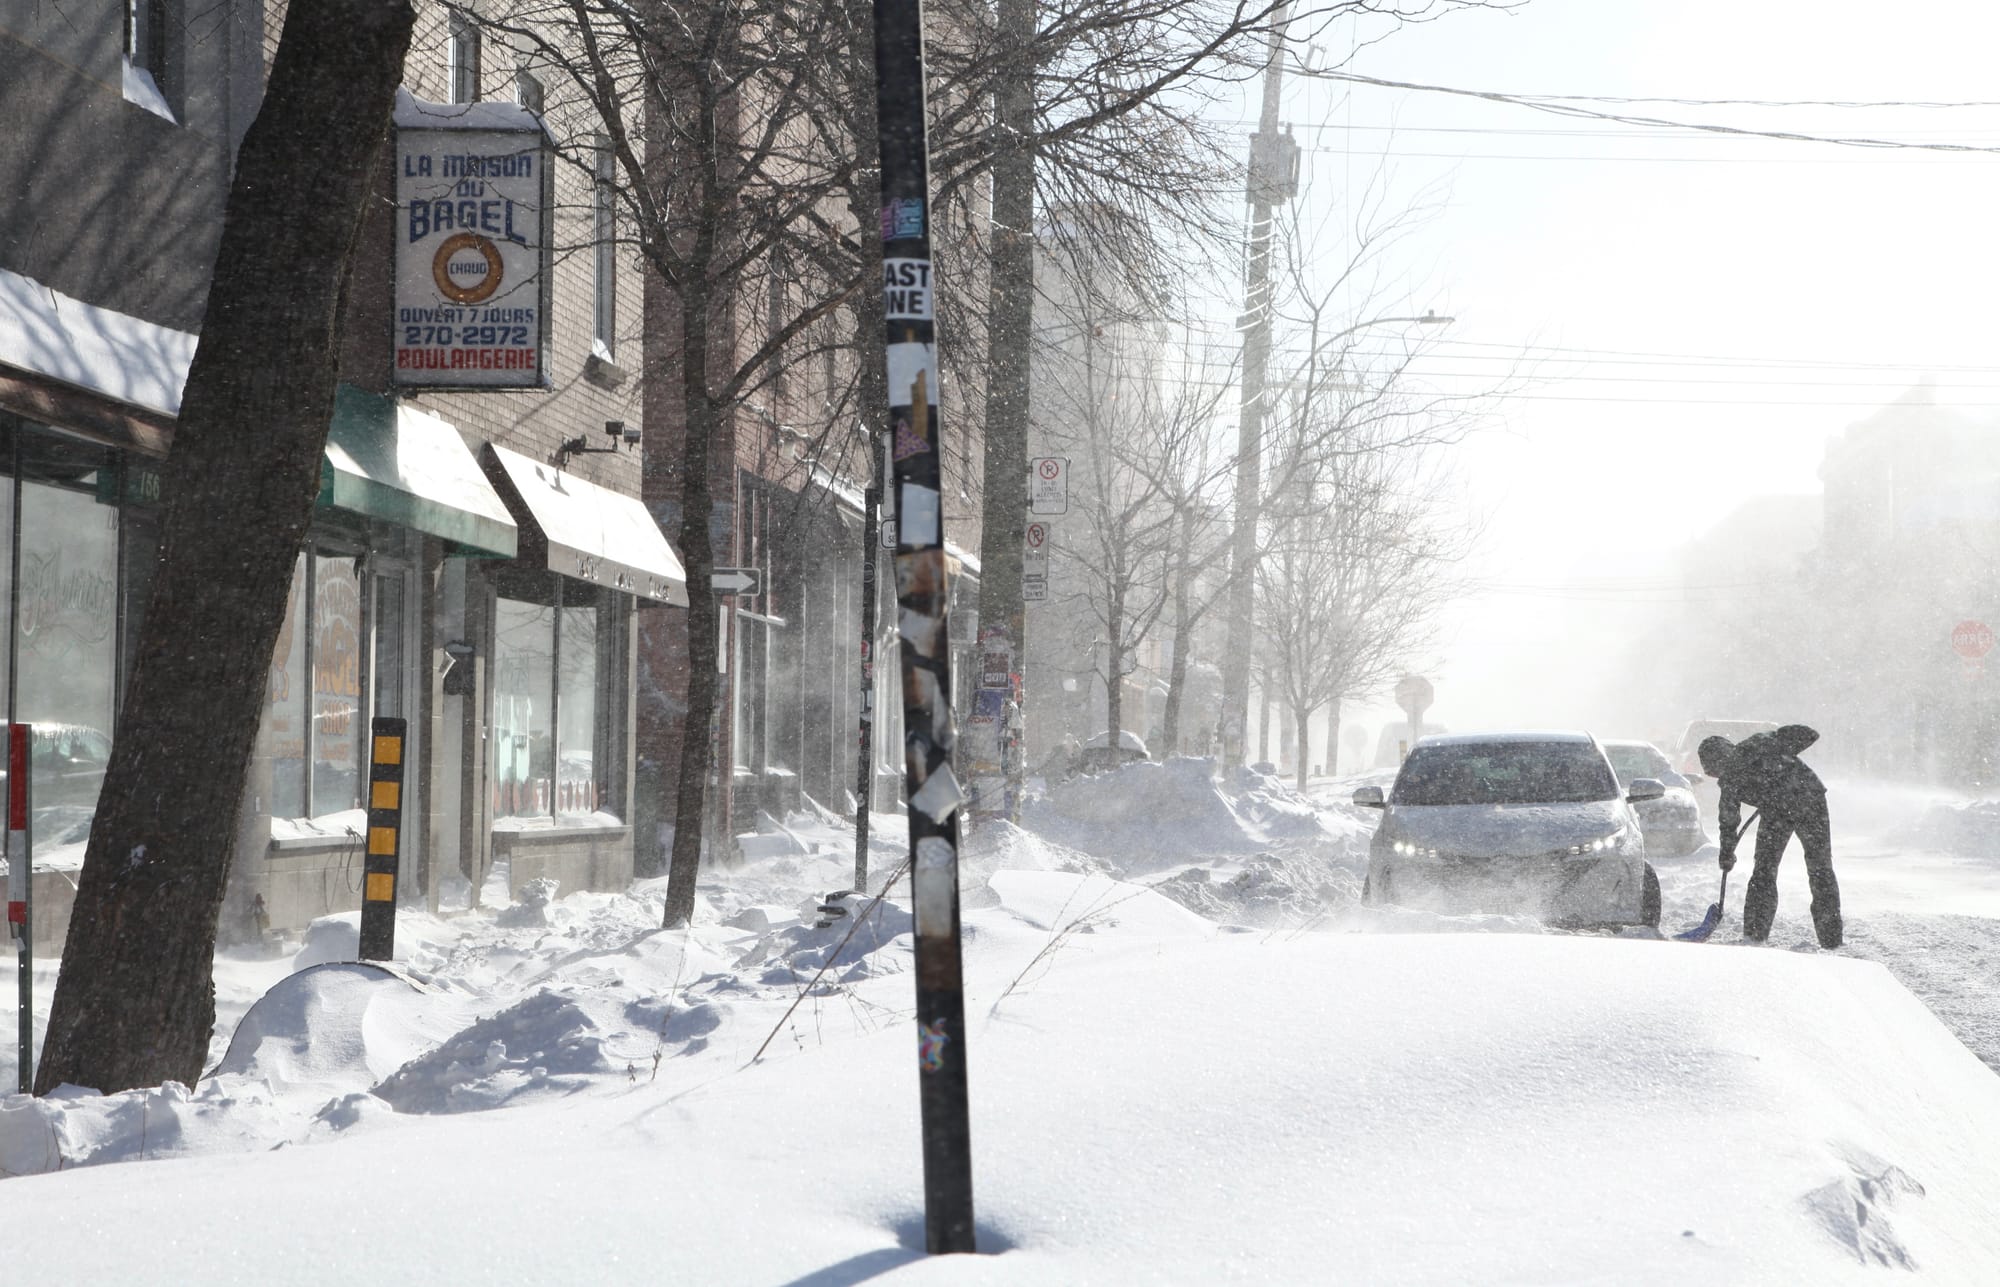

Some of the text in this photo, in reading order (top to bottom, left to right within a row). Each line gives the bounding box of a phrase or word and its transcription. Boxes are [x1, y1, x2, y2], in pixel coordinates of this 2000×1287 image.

[405, 155, 531, 177] LA MAISON
[456, 181, 485, 198] DU
[410, 200, 526, 243] BAGEL
[450, 262, 487, 275] CHAUD
[885, 289, 924, 314] NE
[400, 308, 534, 324] OUVERT 7 JOURS
[405, 326, 528, 345] 270-2972
[397, 349, 536, 370] BOULANGERIE
